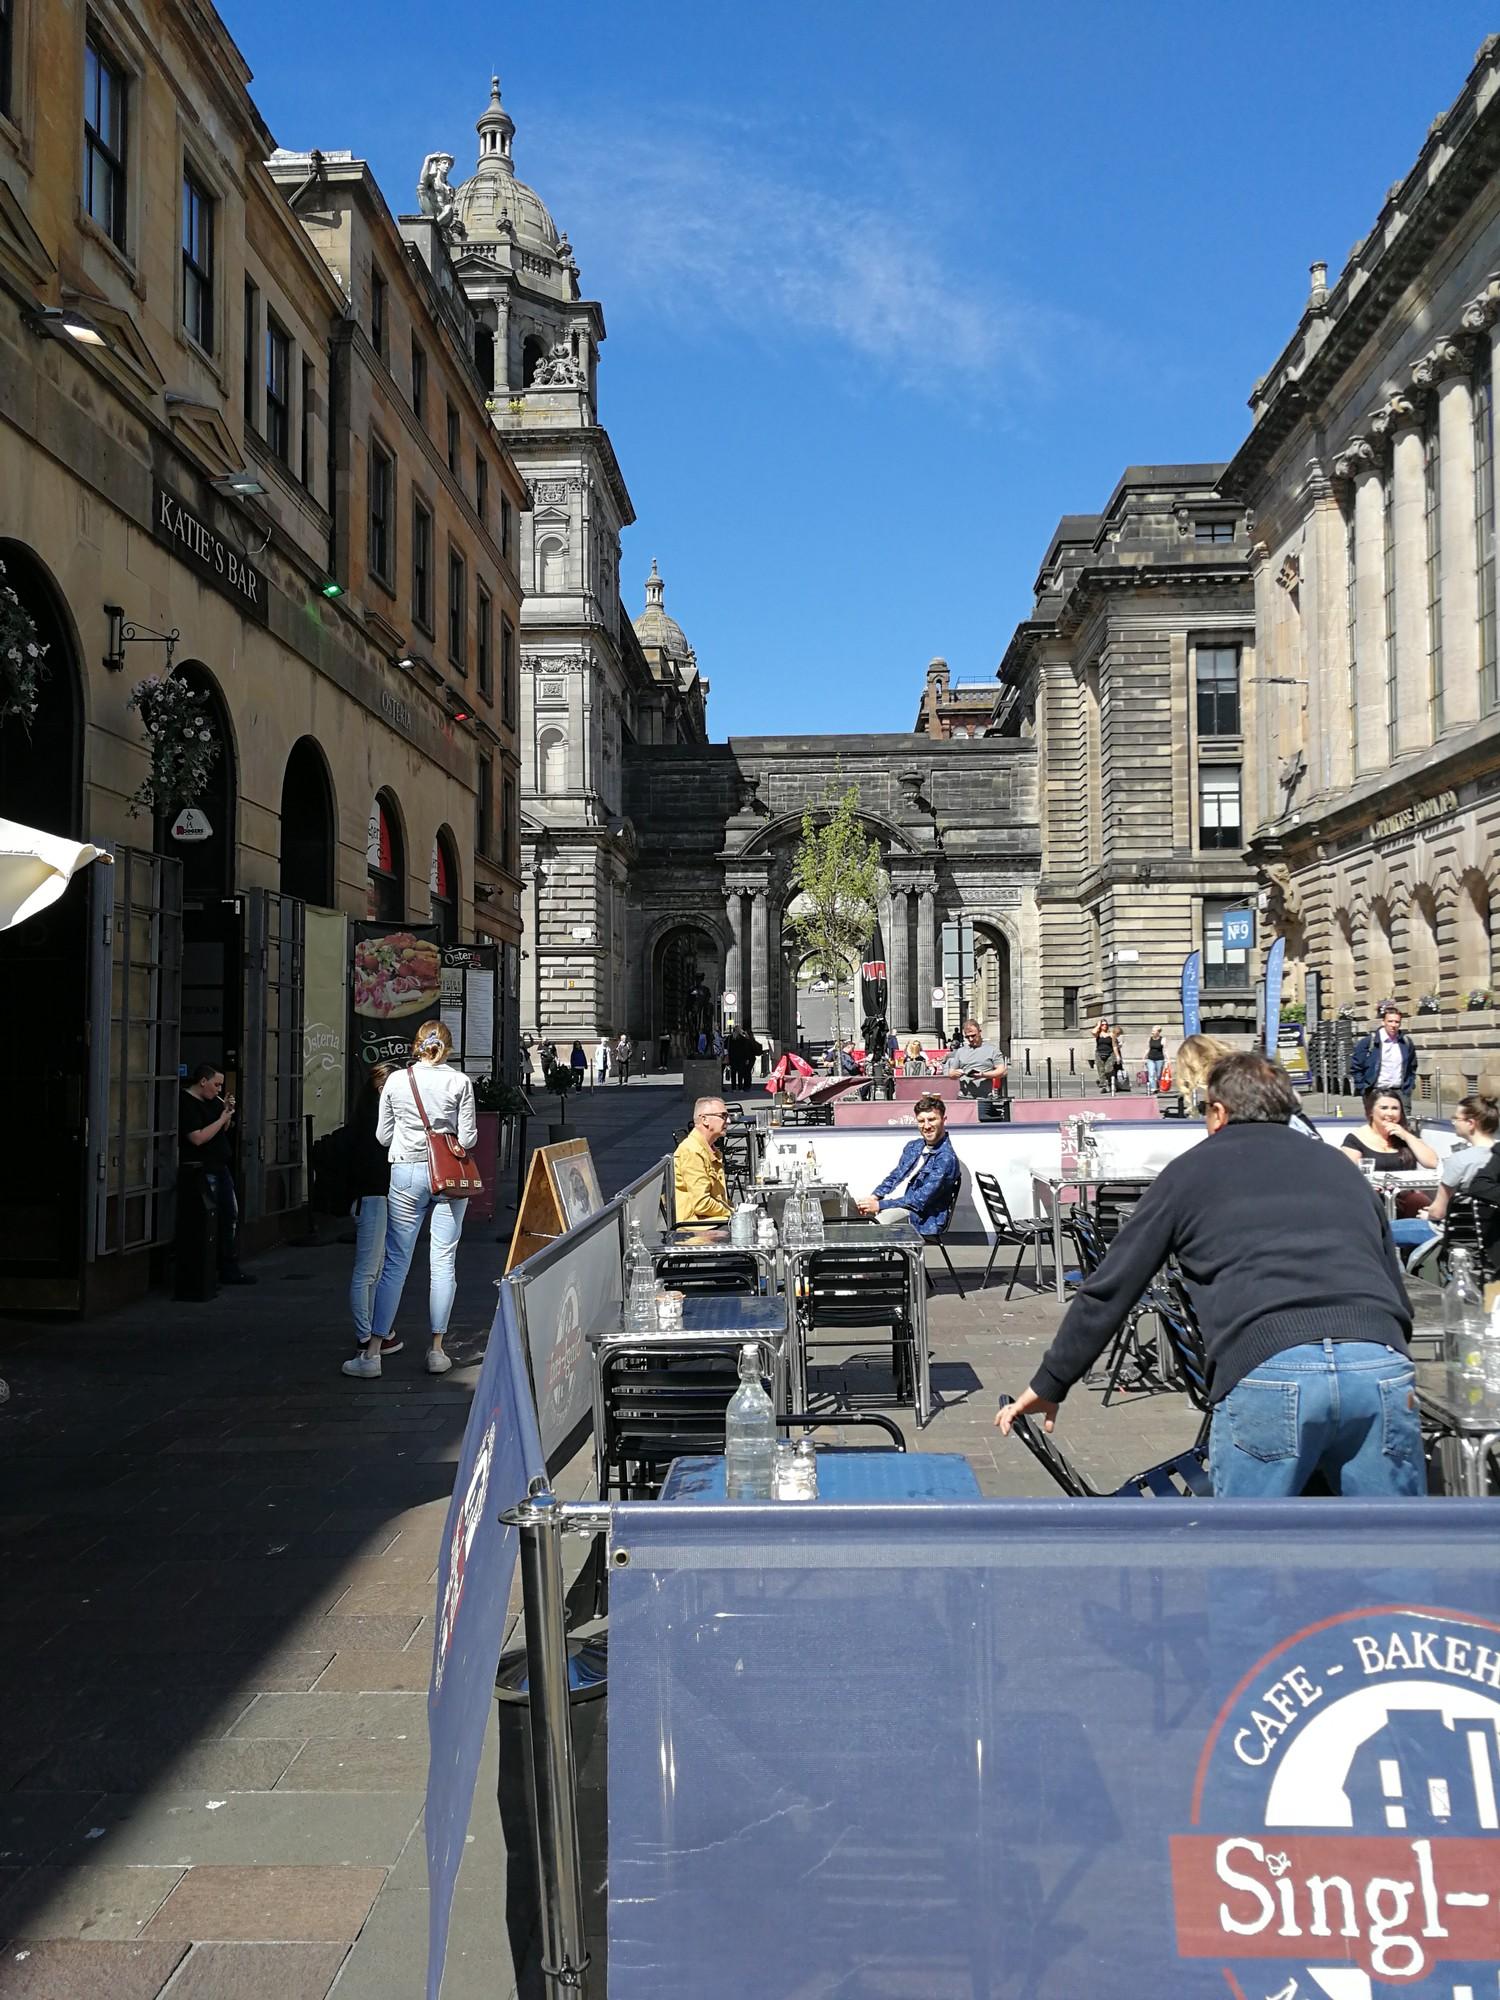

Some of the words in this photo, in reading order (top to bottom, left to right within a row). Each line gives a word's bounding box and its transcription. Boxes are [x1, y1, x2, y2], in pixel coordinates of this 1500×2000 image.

[160, 490, 224, 574] KATIE'S
[228, 551, 258, 604] BAR
[382, 690, 412, 732] OSTERIA
[444, 950, 481, 965] Osteria
[303, 1029, 341, 1059] Osteria
[362, 1041, 412, 1064] Oster
[1234, 1665, 1323, 1765] CAFE
[1353, 1631, 1500, 1689] BAKEH
[1216, 1837, 1500, 1976] Singl-
